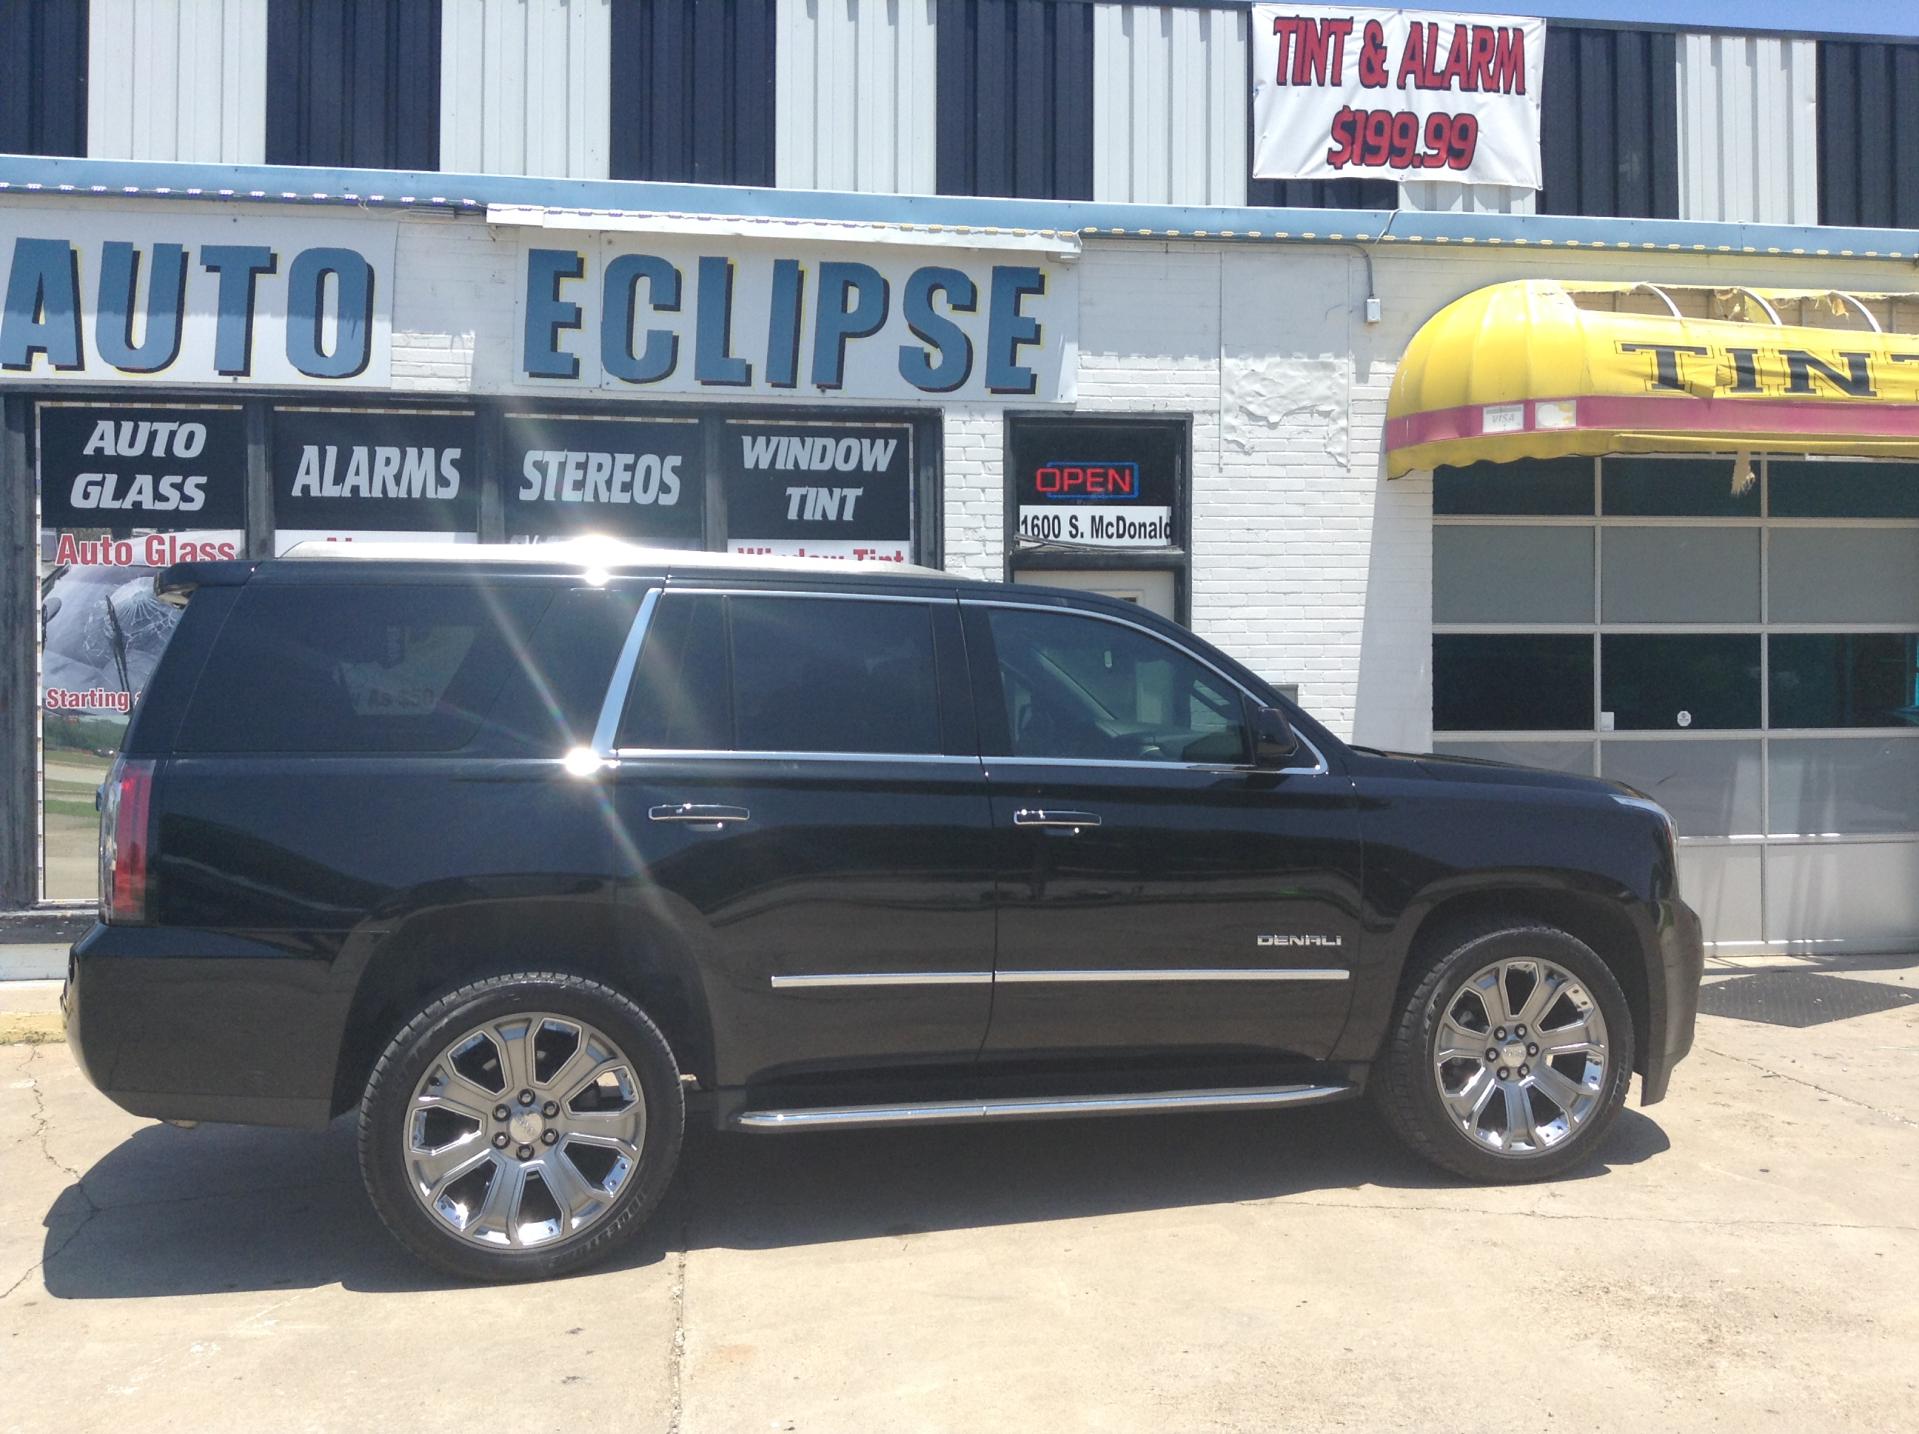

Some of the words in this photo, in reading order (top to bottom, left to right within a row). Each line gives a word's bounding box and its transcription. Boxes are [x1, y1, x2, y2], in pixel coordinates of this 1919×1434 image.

[1273, 15, 1353, 87] TINT
[1358, 19, 1389, 89] &
[1397, 21, 1526, 95] ALARM
[1326, 105, 1478, 170] $199.99
[0, 236, 375, 380] AUTO
[522, 247, 1045, 395] ECLIPSE
[83, 420, 207, 458] AUTO
[741, 435, 897, 472] WINDOW
[291, 445, 462, 500] ALARMS
[519, 449, 682, 506] STEREOS
[1036, 468, 1132, 493] OPEN
[70, 473, 208, 511] GLASS
[785, 486, 864, 521] TINT
[1021, 514, 1062, 538] 1600
[1068, 514, 1084, 539] S.
[1090, 515, 1172, 540] McDonald
[55, 534, 133, 566] Auto
[144, 534, 236, 566] Glass
[46, 688, 129, 712] Starting
[1257, 934, 1342, 946] DENALI
